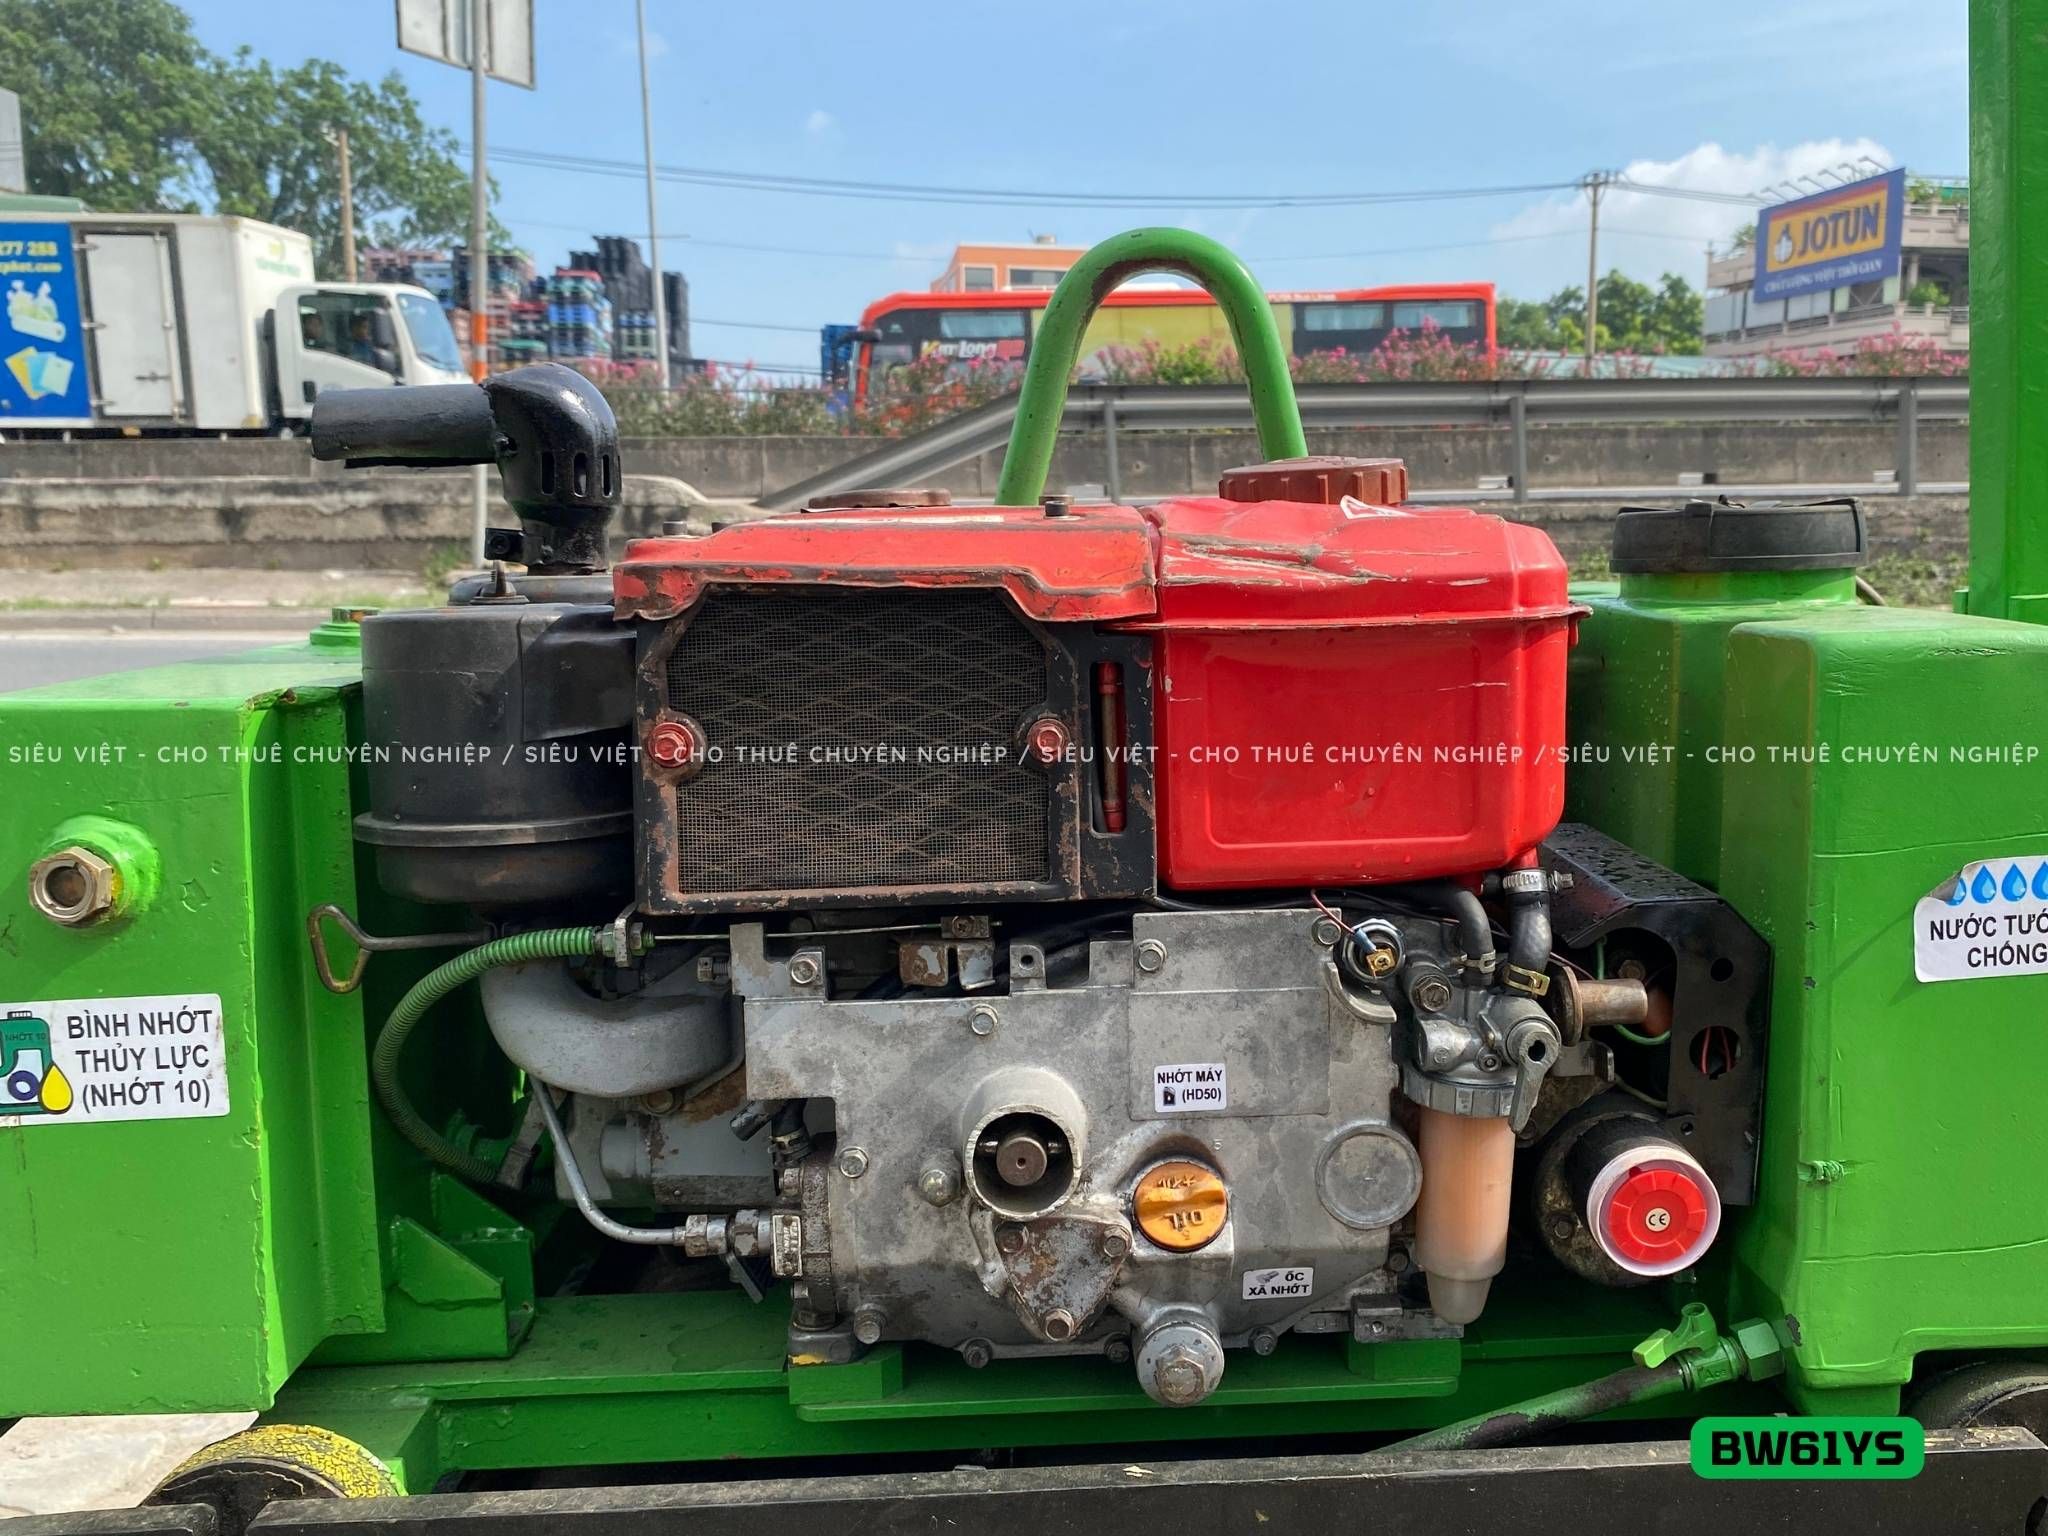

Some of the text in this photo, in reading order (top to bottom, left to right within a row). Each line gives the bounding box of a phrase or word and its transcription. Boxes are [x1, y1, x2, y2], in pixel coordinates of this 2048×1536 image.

[1797, 201, 1880, 259] JOTUN
[959, 340, 998, 359] Long
[1930, 912, 1997, 941] NƯỚC
[1967, 940, 2048, 968] CHỐNG
[67, 1005, 212, 1039] BÌNH NHỚT
[75, 1042, 210, 1075] THỦY LỰC
[1157, 1067, 1223, 1084] NHỚT MÁY
[82, 1076, 211, 1114] (NHỚT 10)
[1182, 1087, 1222, 1103] (HD50)
[1163, 1208, 1205, 1231] OIL
[1648, 1213, 1667, 1226] CE
[1285, 1270, 1305, 1282] ỐC
[1271, 1283, 1310, 1295] NHỚT
